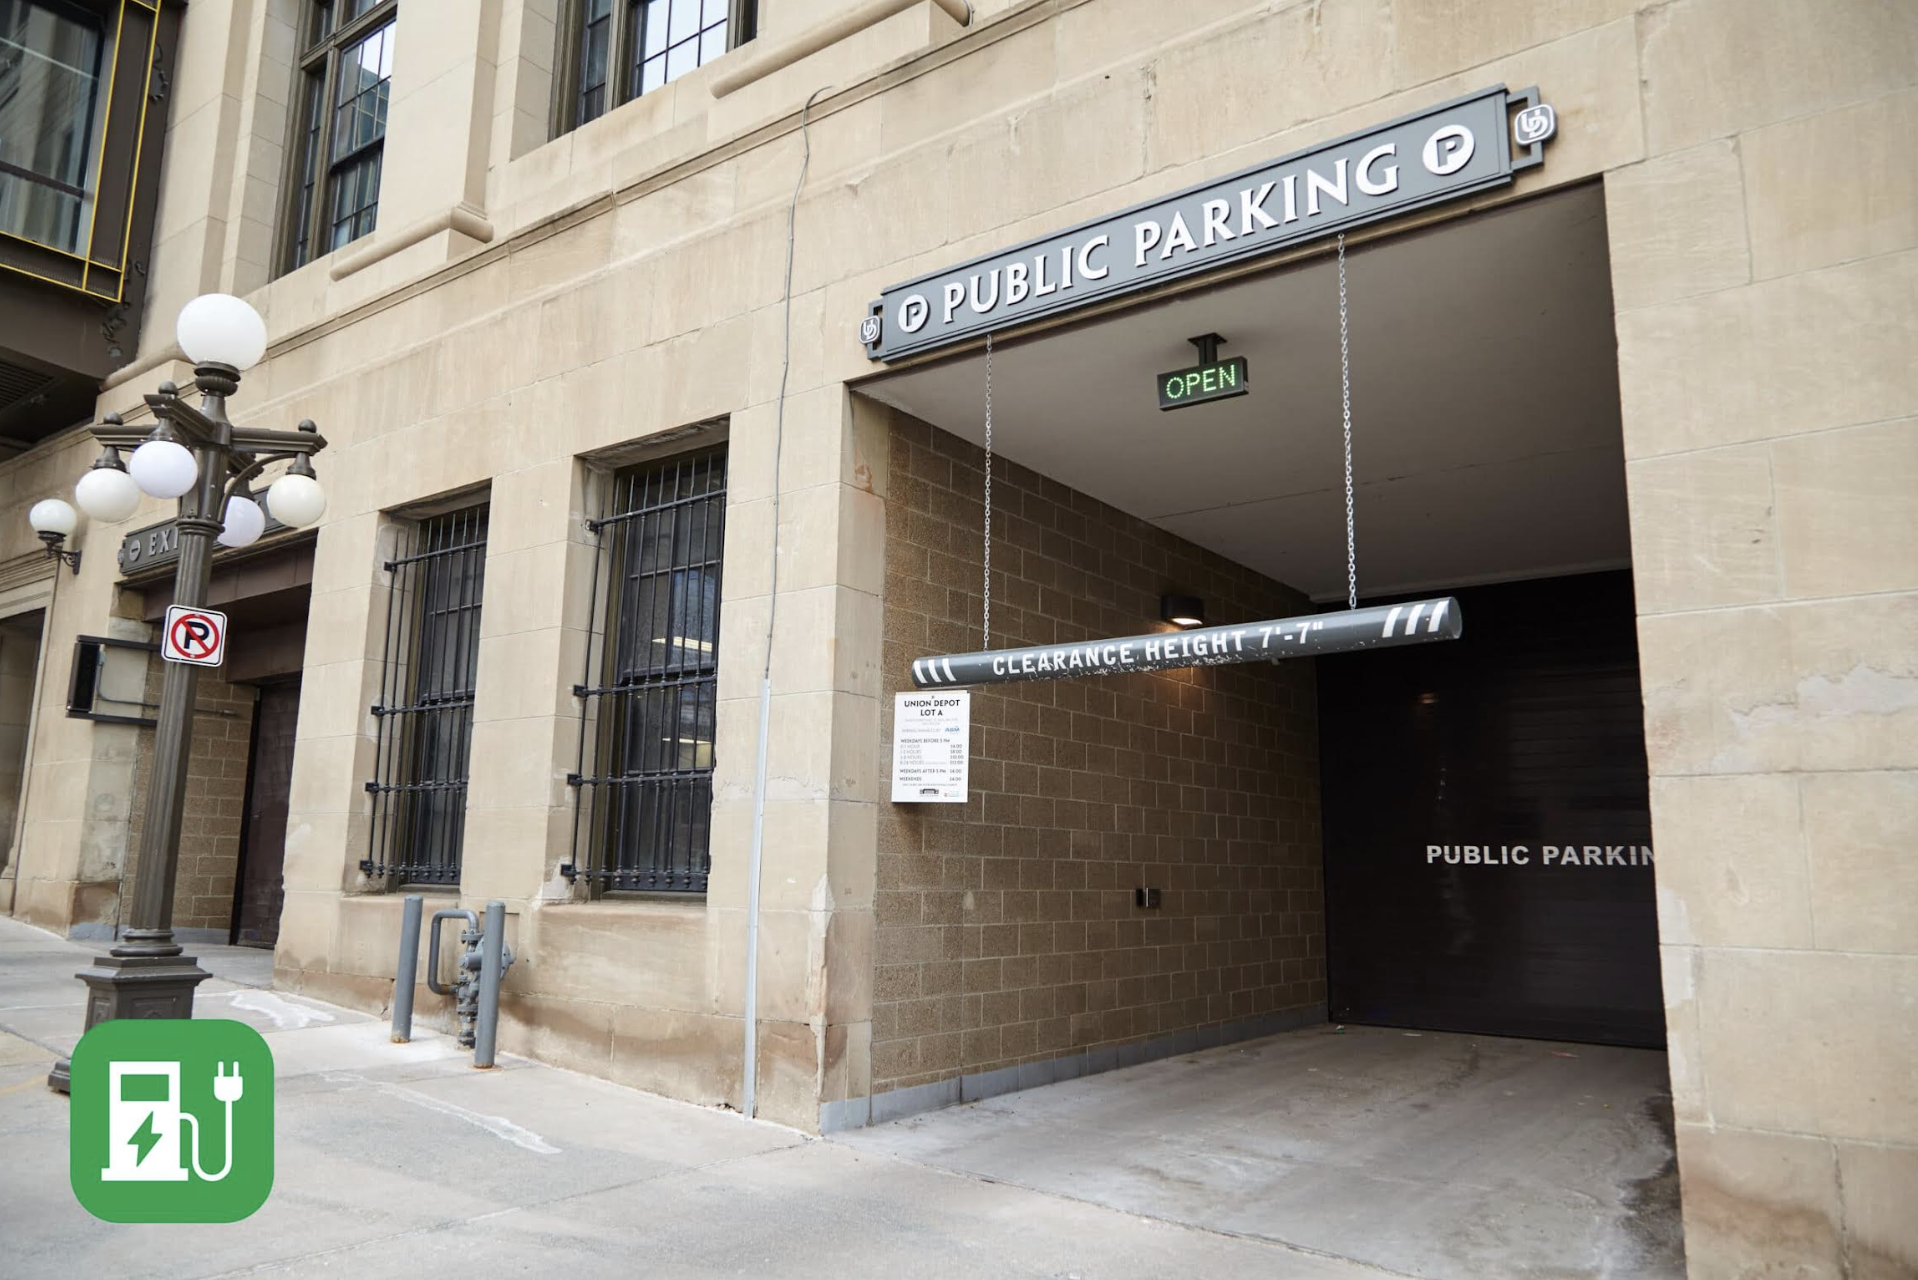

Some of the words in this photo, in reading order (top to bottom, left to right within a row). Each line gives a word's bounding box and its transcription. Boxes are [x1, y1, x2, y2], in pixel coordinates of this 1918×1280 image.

[942, 234, 1109, 324] PUBLIC
[1134, 142, 1400, 267] PARKING
[1166, 364, 1236, 399] OPEN
[148, 527, 179, 557] EXI
[992, 642, 1135, 677] CLEARANCE
[1145, 629, 1247, 662] HEIGHT
[1259, 621, 1325, 649] 7'-7"
[904, 700, 932, 708] UNION
[934, 699, 961, 707] DEPOT
[920, 709, 936, 717] LOT
[1426, 845, 1530, 865] PUBLIC
[1542, 845, 1655, 866] PARKIN
